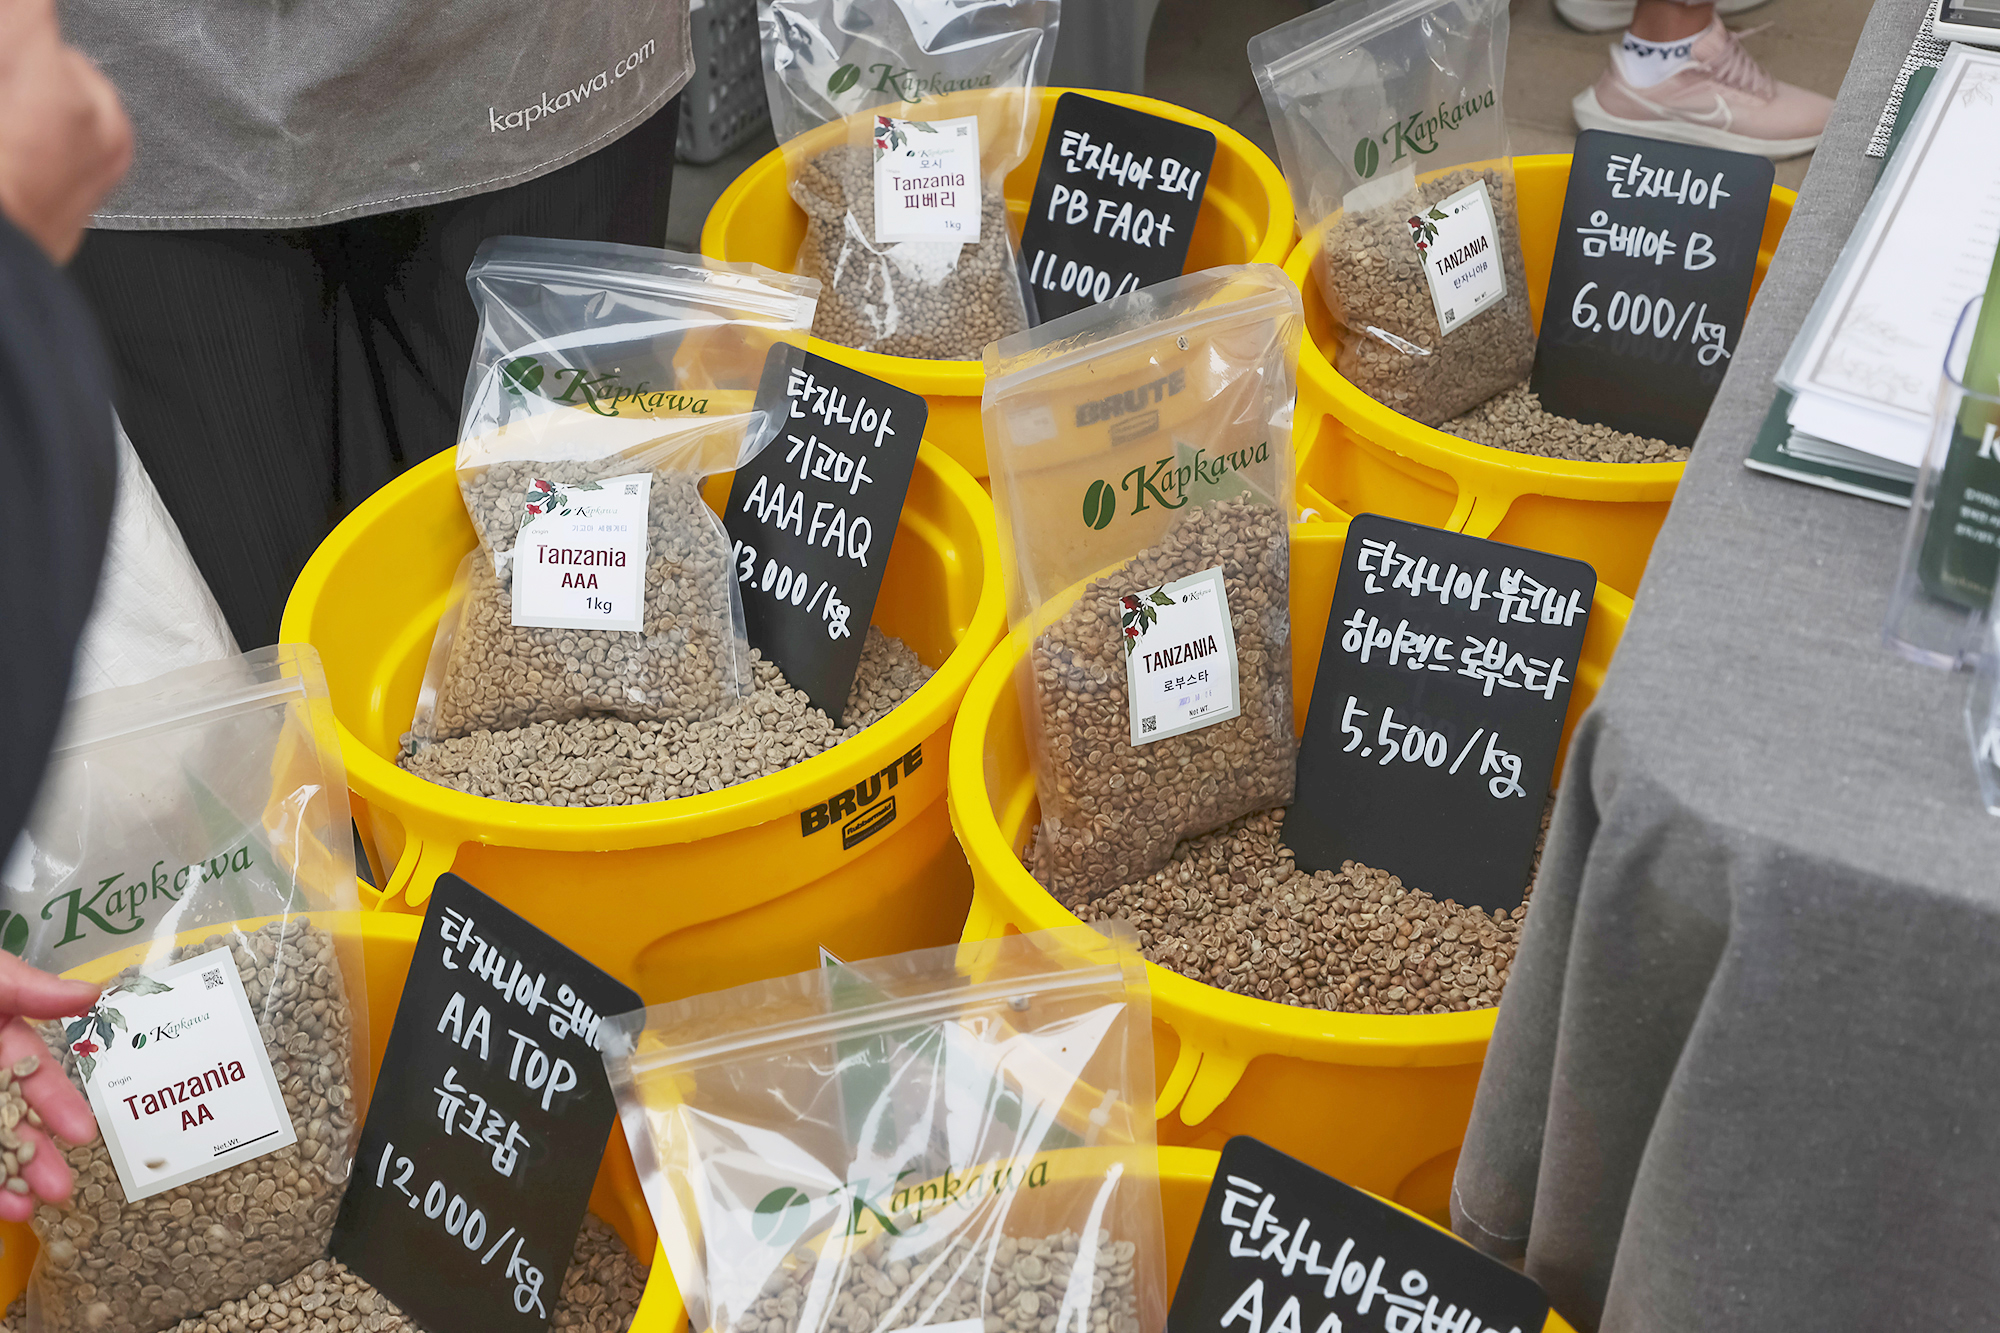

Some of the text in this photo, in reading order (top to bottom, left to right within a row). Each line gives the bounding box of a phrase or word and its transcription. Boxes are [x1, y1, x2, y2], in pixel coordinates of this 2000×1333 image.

[489, 38, 655, 132] kapkawa.com
[868, 63, 992, 104] Kapkawa
[1382, 89, 1496, 164] Kapkawa
[893, 172, 965, 191] Tanzania
[919, 158, 942, 169] 모시
[1060, 129, 1202, 201] 탄자니아 모시
[1606, 153, 1731, 210] 탄자니아
[904, 191, 955, 209] 피베리
[944, 220, 962, 231] 1kg
[1047, 183, 1089, 225] PB
[1435, 235, 1489, 276] TANZANIA
[1576, 209, 1717, 271] 음베야 B
[552, 367, 709, 417] Kapkawa
[786, 367, 896, 448] 탄자니아
[1076, 368, 1186, 427] BRUTE
[785, 434, 873, 495] 기고마
[1121, 441, 1270, 516] Kapkawa
[743, 475, 873, 568] AAA FAQ
[537, 544, 627, 567] Tanzania
[561, 572, 598, 589] AAA
[1357, 538, 1587, 627] 탄자니아 부코바
[586, 597, 612, 614] 1kg
[1143, 634, 1218, 674] TANZANIA
[1163, 669, 1209, 693] 로부스타
[1457, 635, 1570, 700] 로부스타
[800, 742, 923, 838] BRUTE
[41, 846, 254, 948] Kapkawa
[440, 906, 606, 1052] 탄자니아 음베
[149, 1011, 210, 1043] Kapkawa
[436, 991, 577, 1112] AA TOP
[107, 1074, 132, 1088] Origin
[122, 1060, 246, 1121] Tanzania
[180, 1103, 214, 1131] AA
[433, 1066, 531, 1177] 뉴크랍
[1220, 1174, 1388, 1316] 탄자니아
